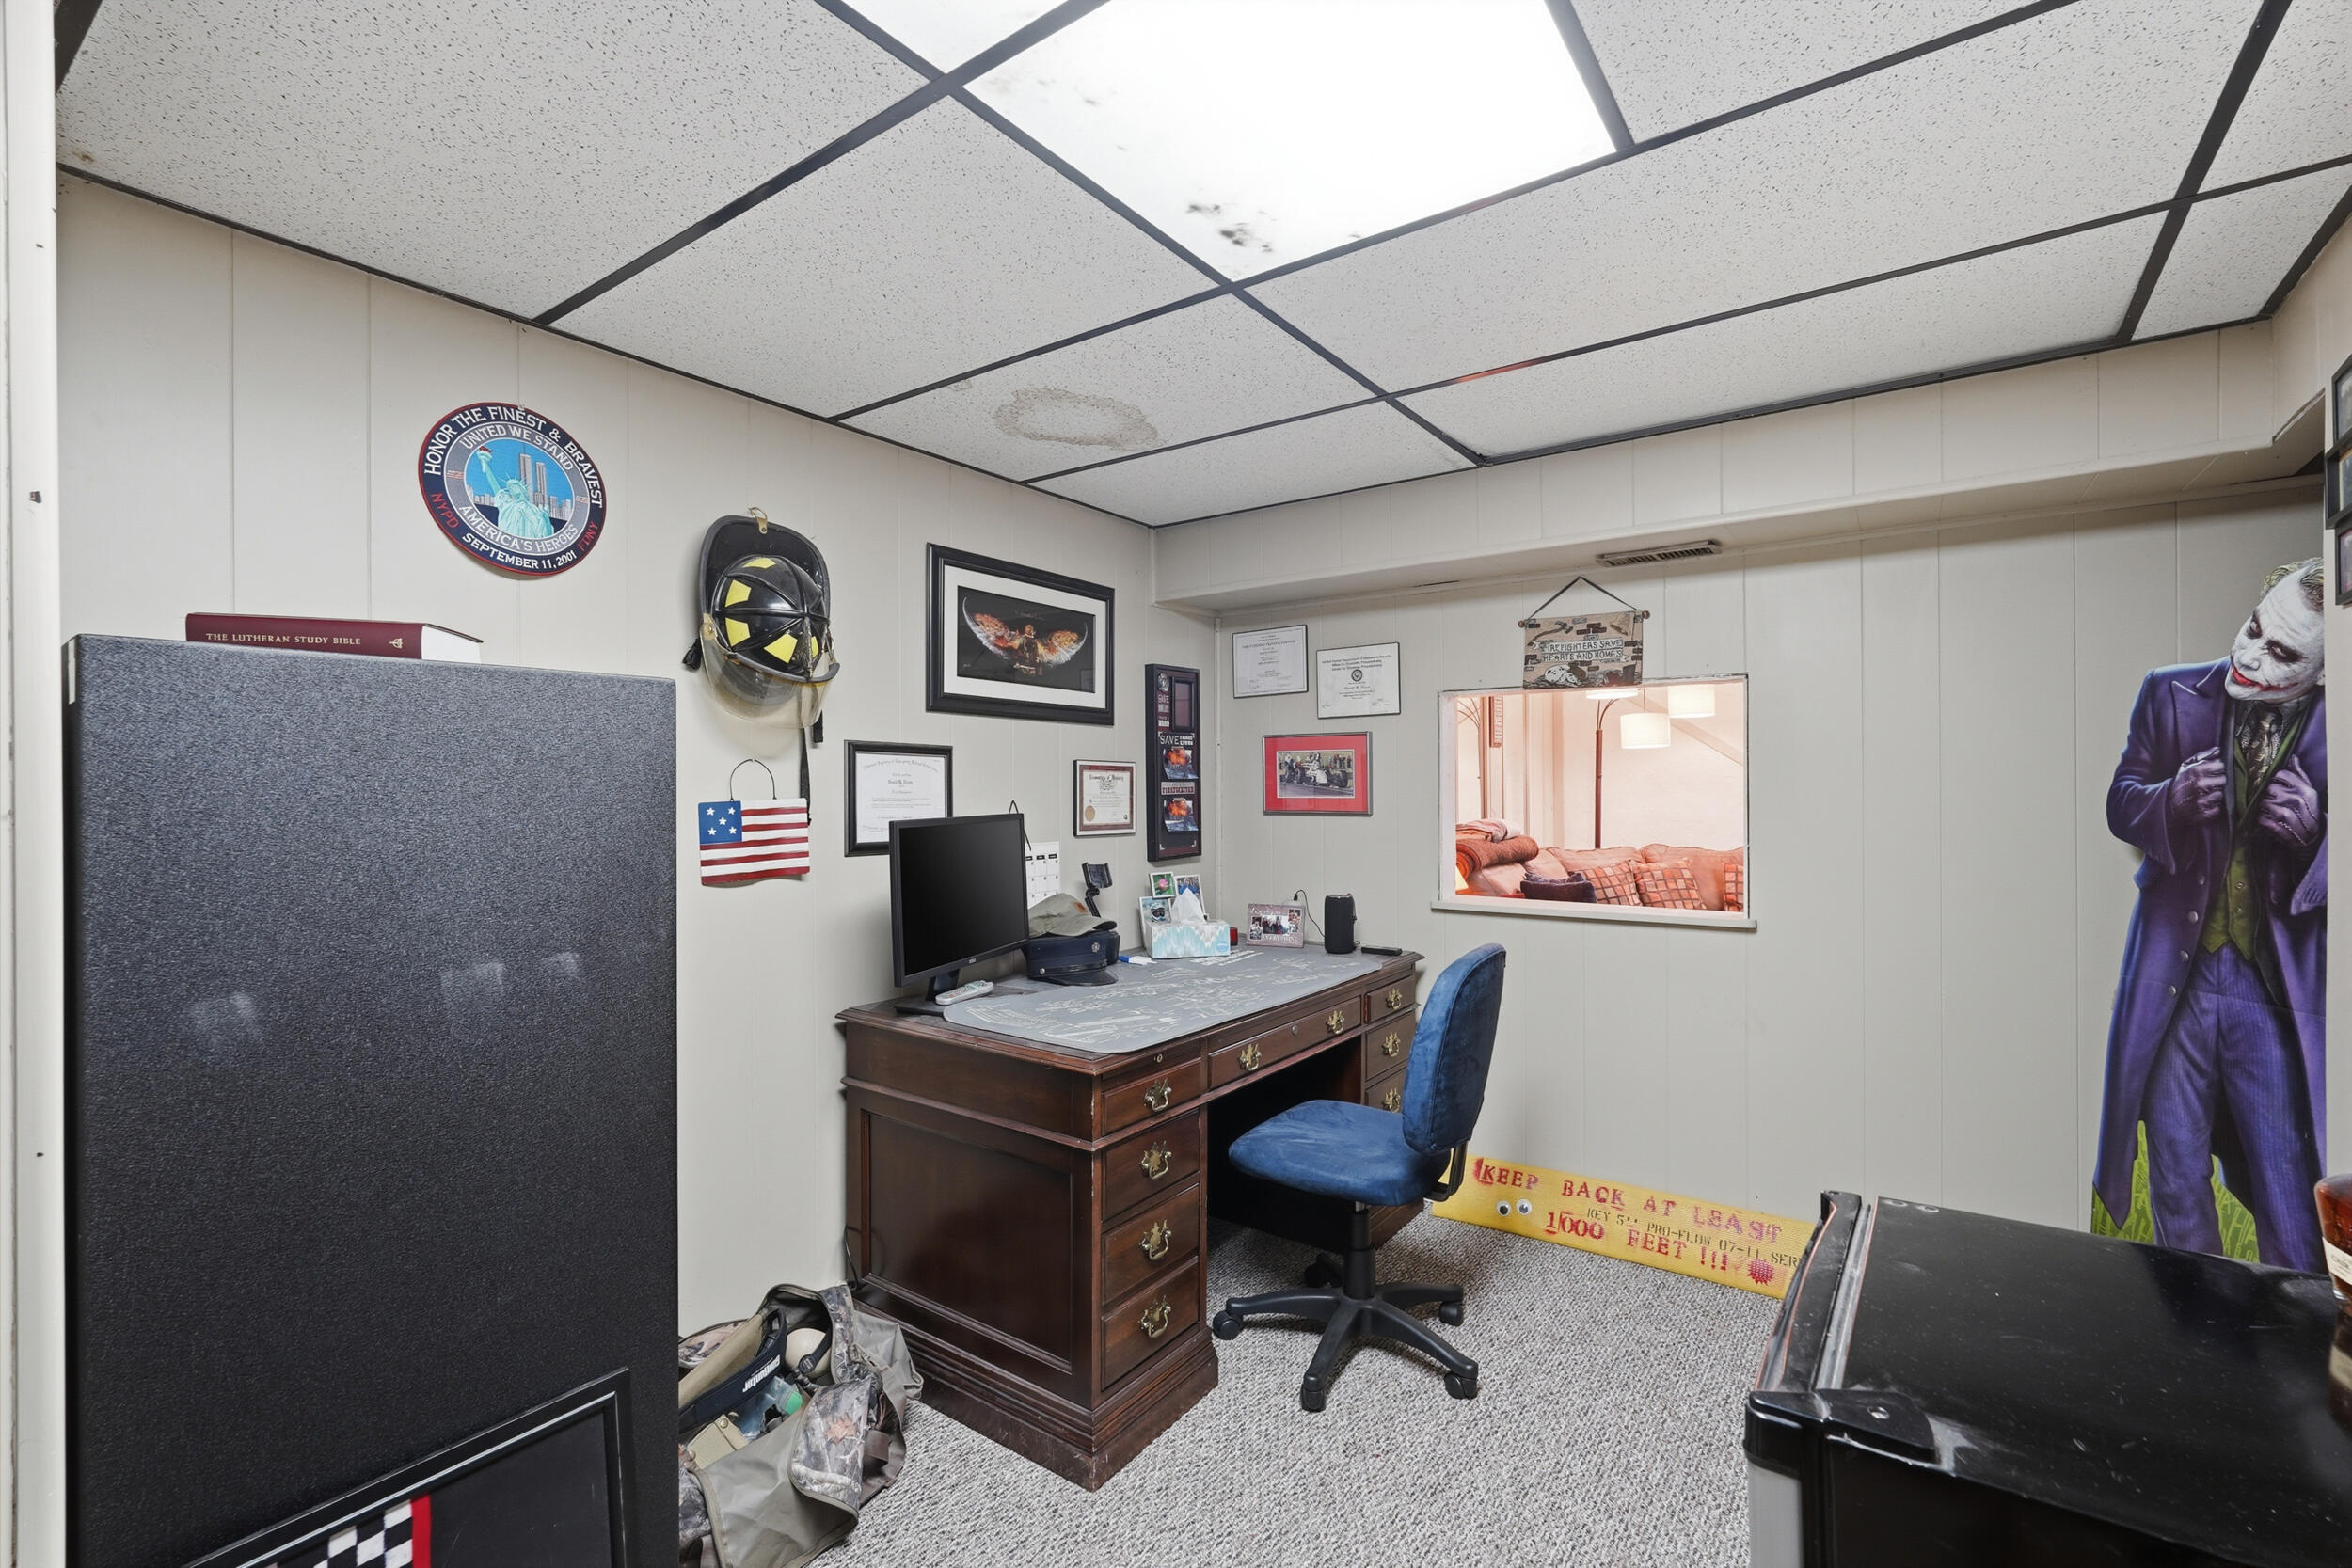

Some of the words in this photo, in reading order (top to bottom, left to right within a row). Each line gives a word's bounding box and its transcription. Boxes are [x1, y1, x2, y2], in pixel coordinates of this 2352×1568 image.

[424, 423, 457, 476] HONOR
[451, 408, 487, 429] THE
[487, 406, 547, 430] FINEST
[549, 428, 560, 442] &
[564, 440, 602, 508] BRAVEST
[460, 424, 506, 450] UNITED
[510, 424, 532, 440] WE
[533, 434, 574, 471] STAND
[431, 493, 459, 529] NYPD
[459, 506, 532, 552] AMERICA'S
[535, 523, 579, 553] HEROES
[577, 520, 598, 551] FDNY
[462, 532, 539, 569] SEPTEMBER
[206, 632, 229, 641] THE
[232, 633, 291, 643] LUTHERAN
[294, 636, 328, 645] STUDY
[333, 637, 361, 645] BIBLE
[1576, 650, 1593, 660] AND
[1595, 649, 1623, 659] HOMES
[1160, 735, 1180, 745] SAVE
[1481, 1164, 1539, 1190] KEEP
[1561, 1180, 1626, 1206] BACK
[1643, 1196, 1677, 1217] AT
[1692, 1205, 1782, 1244] LEAST
[1587, 1208, 1611, 1222] KEY
[1646, 1223, 1712, 1246] PRO-FLOW
[1771, 1251, 1801, 1268] SER
[1627, 1228, 1687, 1259] FEET
